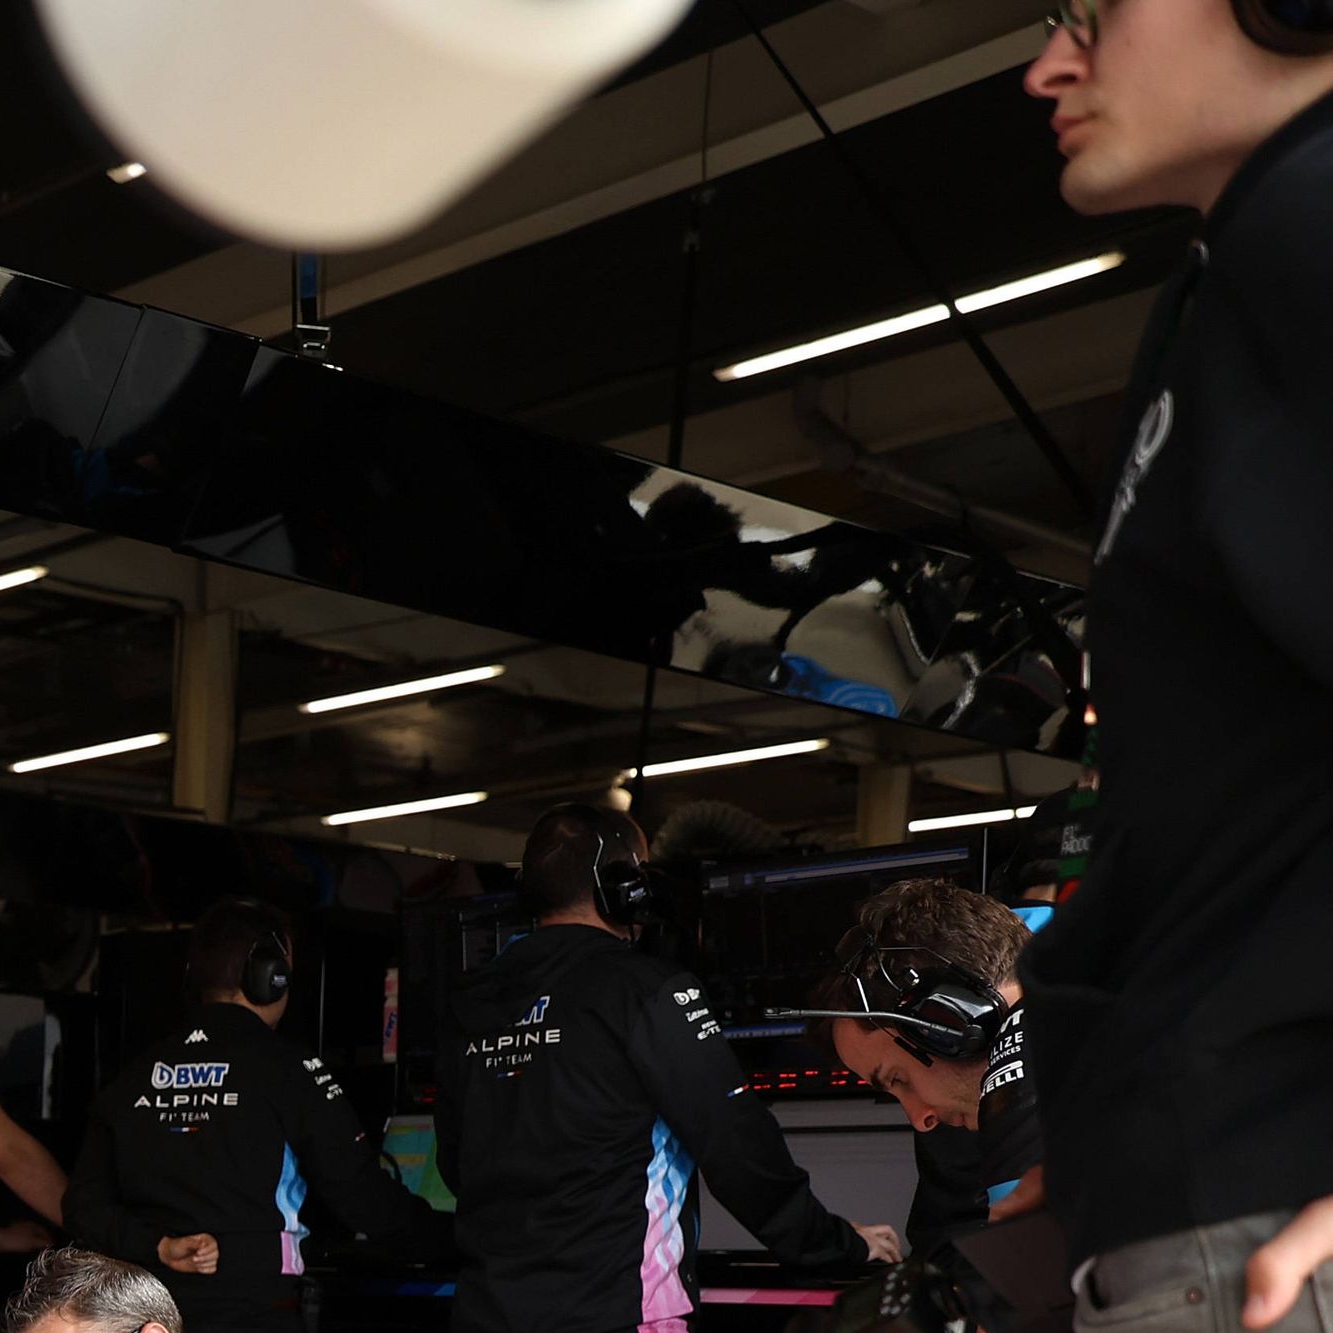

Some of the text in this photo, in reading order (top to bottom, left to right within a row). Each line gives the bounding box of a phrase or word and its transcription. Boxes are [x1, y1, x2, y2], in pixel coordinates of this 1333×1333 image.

[465, 1028, 561, 1056] ALPINE
[505, 1053, 533, 1065] TEAM
[174, 1062, 231, 1087] BWT
[133, 1092, 239, 1109] ALPINE
[181, 1111, 210, 1122] TEAM
